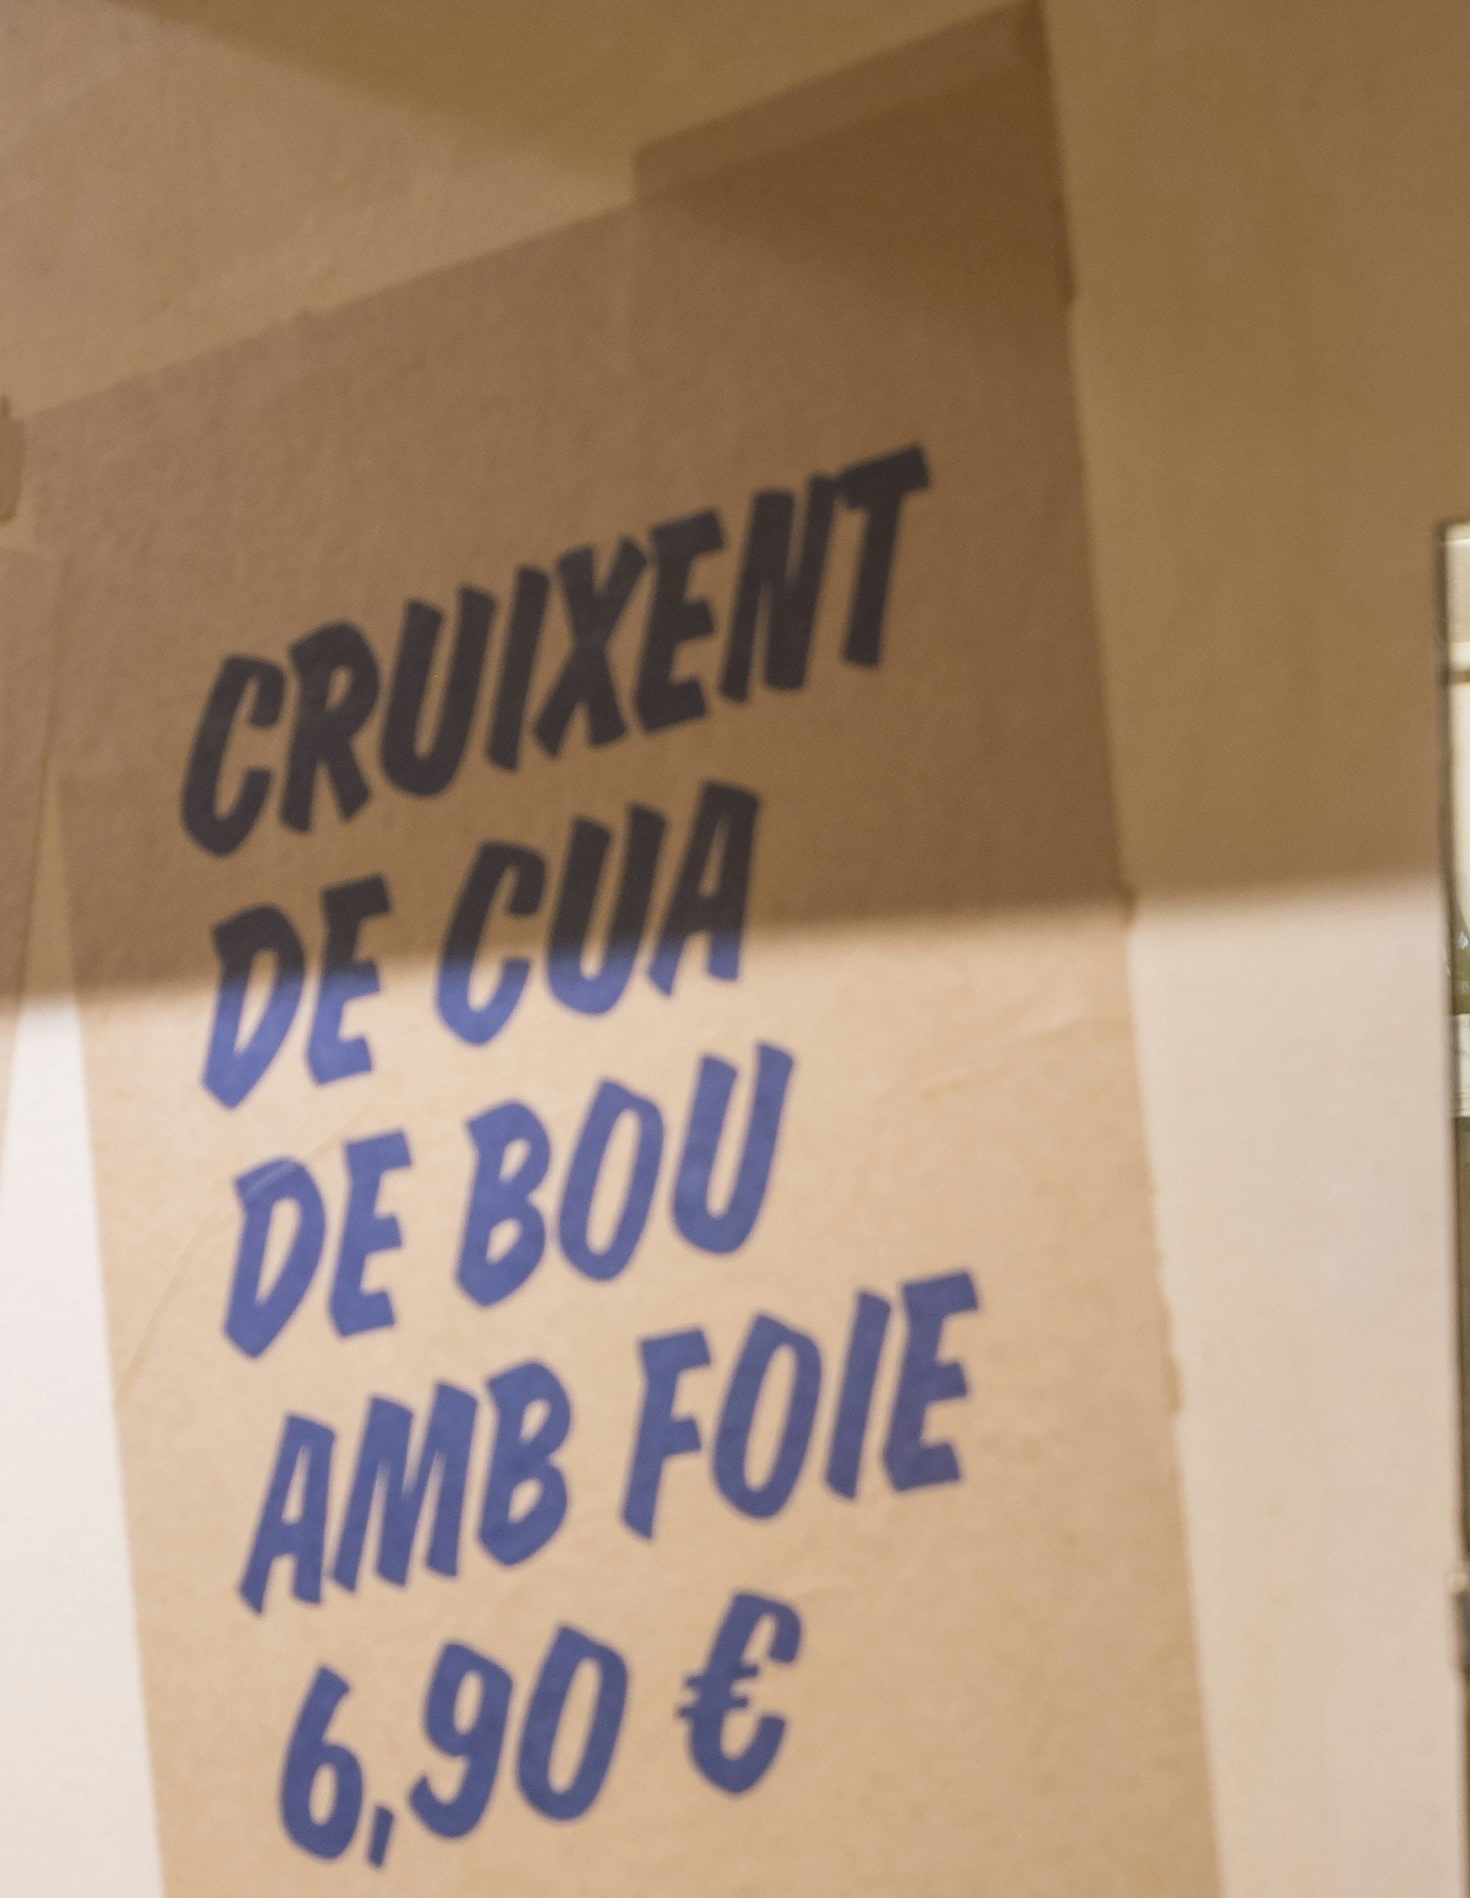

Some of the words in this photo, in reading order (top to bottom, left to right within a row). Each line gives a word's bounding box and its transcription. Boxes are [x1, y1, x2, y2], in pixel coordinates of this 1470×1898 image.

[181, 443, 931, 859] CRUIXENT
[200, 872, 392, 1110] DE
[435, 781, 761, 1048] CUA
[223, 1128, 411, 1359] DE
[454, 1042, 795, 1308] BOU
[239, 1359, 572, 1617] AMB
[621, 1269, 980, 1542] FOIE
[278, 1621, 630, 1872] 6,90
[675, 1588, 802, 1796] €
